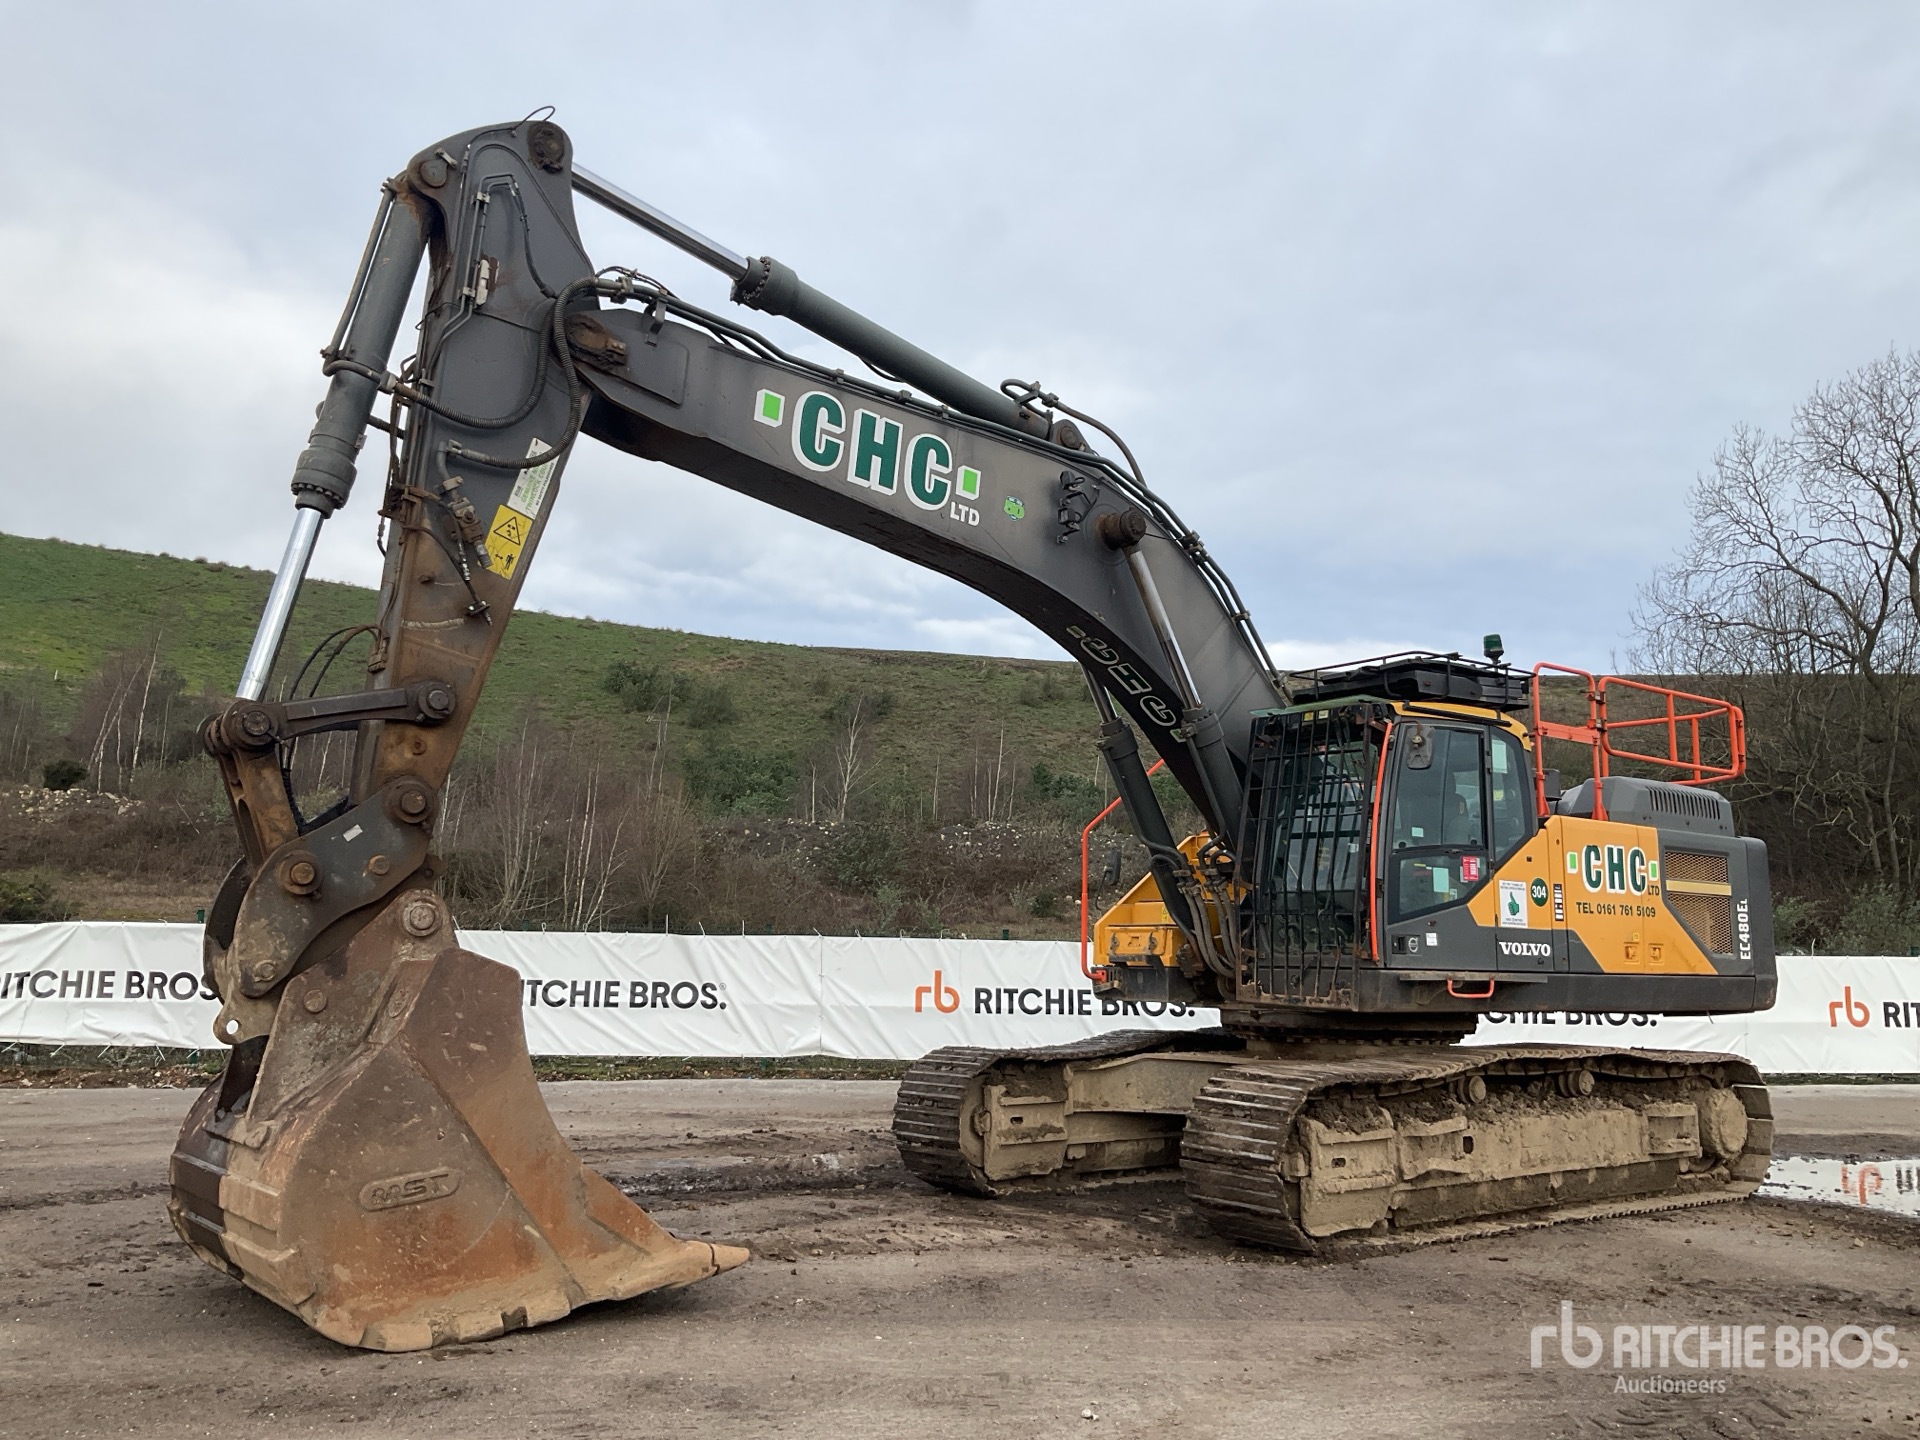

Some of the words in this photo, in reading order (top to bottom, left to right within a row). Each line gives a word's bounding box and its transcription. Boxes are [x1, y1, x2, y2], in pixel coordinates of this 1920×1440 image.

[792, 391, 953, 511] CHC
[950, 501, 980, 527] LTD
[1582, 844, 1648, 896] CHC
[1532, 885, 1547, 899] 304
[1648, 885, 1660, 896] LTD
[1576, 902, 1594, 914] TEL
[1597, 903, 1616, 915] 0161
[1620, 905, 1633, 916] 761
[1636, 906, 1656, 918] 5109
[1498, 941, 1551, 957] VOLVO
[0, 970, 115, 999] ITCHIE
[630, 981, 726, 1010] BROS.
[915, 970, 960, 1013] rb
[975, 987, 1092, 1017] RITCHIE
[1829, 986, 1870, 1028] rb
